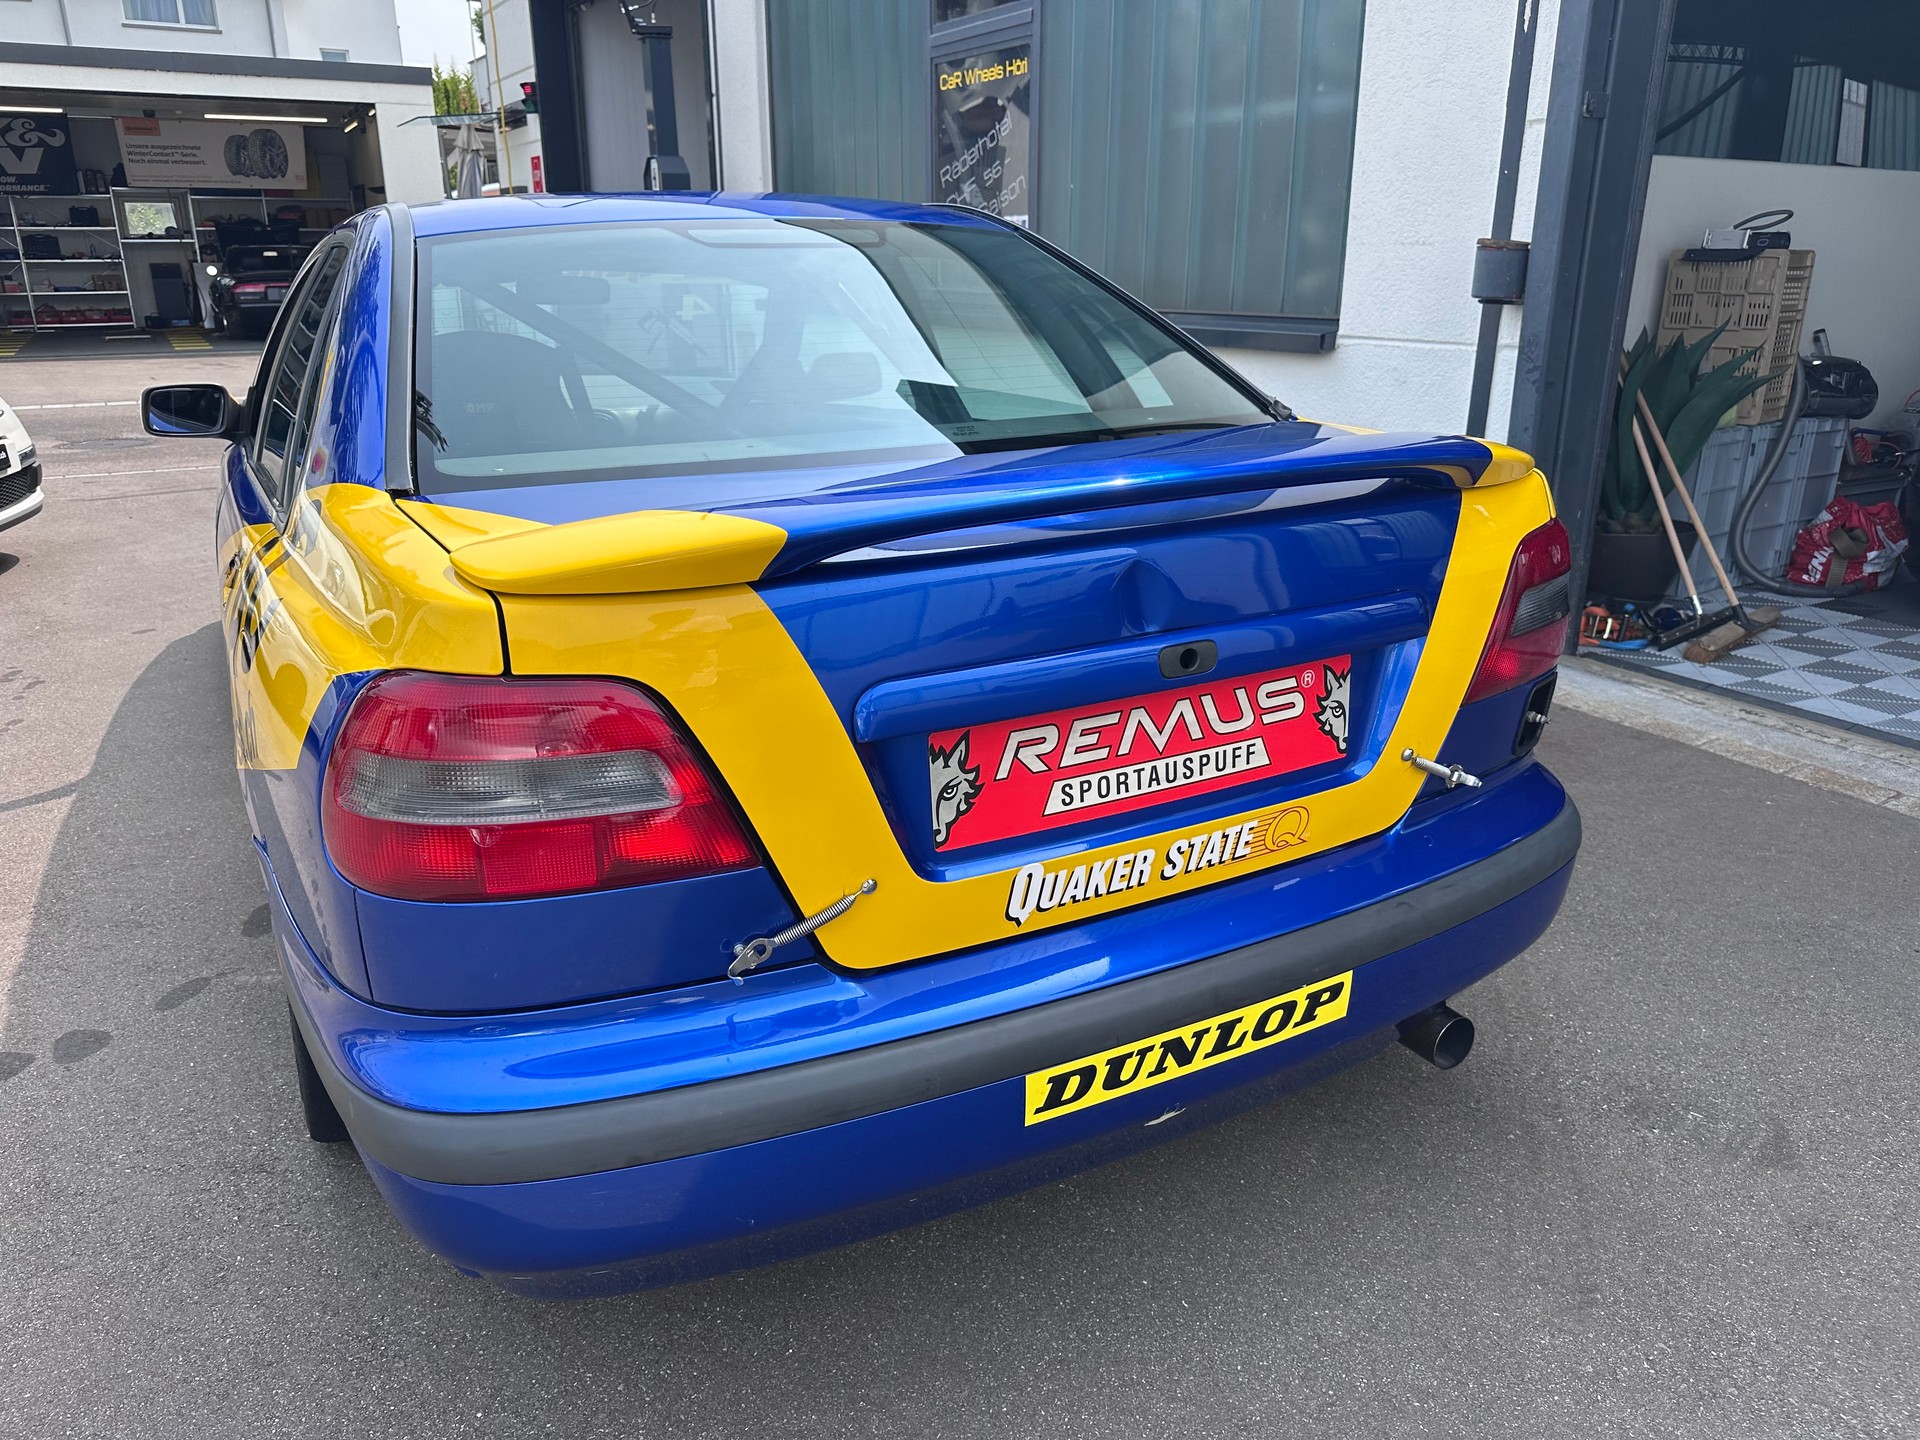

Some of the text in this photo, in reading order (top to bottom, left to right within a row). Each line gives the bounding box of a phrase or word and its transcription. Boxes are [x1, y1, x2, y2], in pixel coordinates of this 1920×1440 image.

[964, 63, 1004, 86] Wheels
[150, 143, 201, 151] ausgezeichnete
[940, 112, 1013, 188] Räderhotel
[1060, 742, 1257, 807] SPORTAUSPUFF
[1004, 847, 1155, 928] QUAKER
[1160, 820, 1259, 881] STATE
[1033, 981, 1345, 1115] DUNLOP
